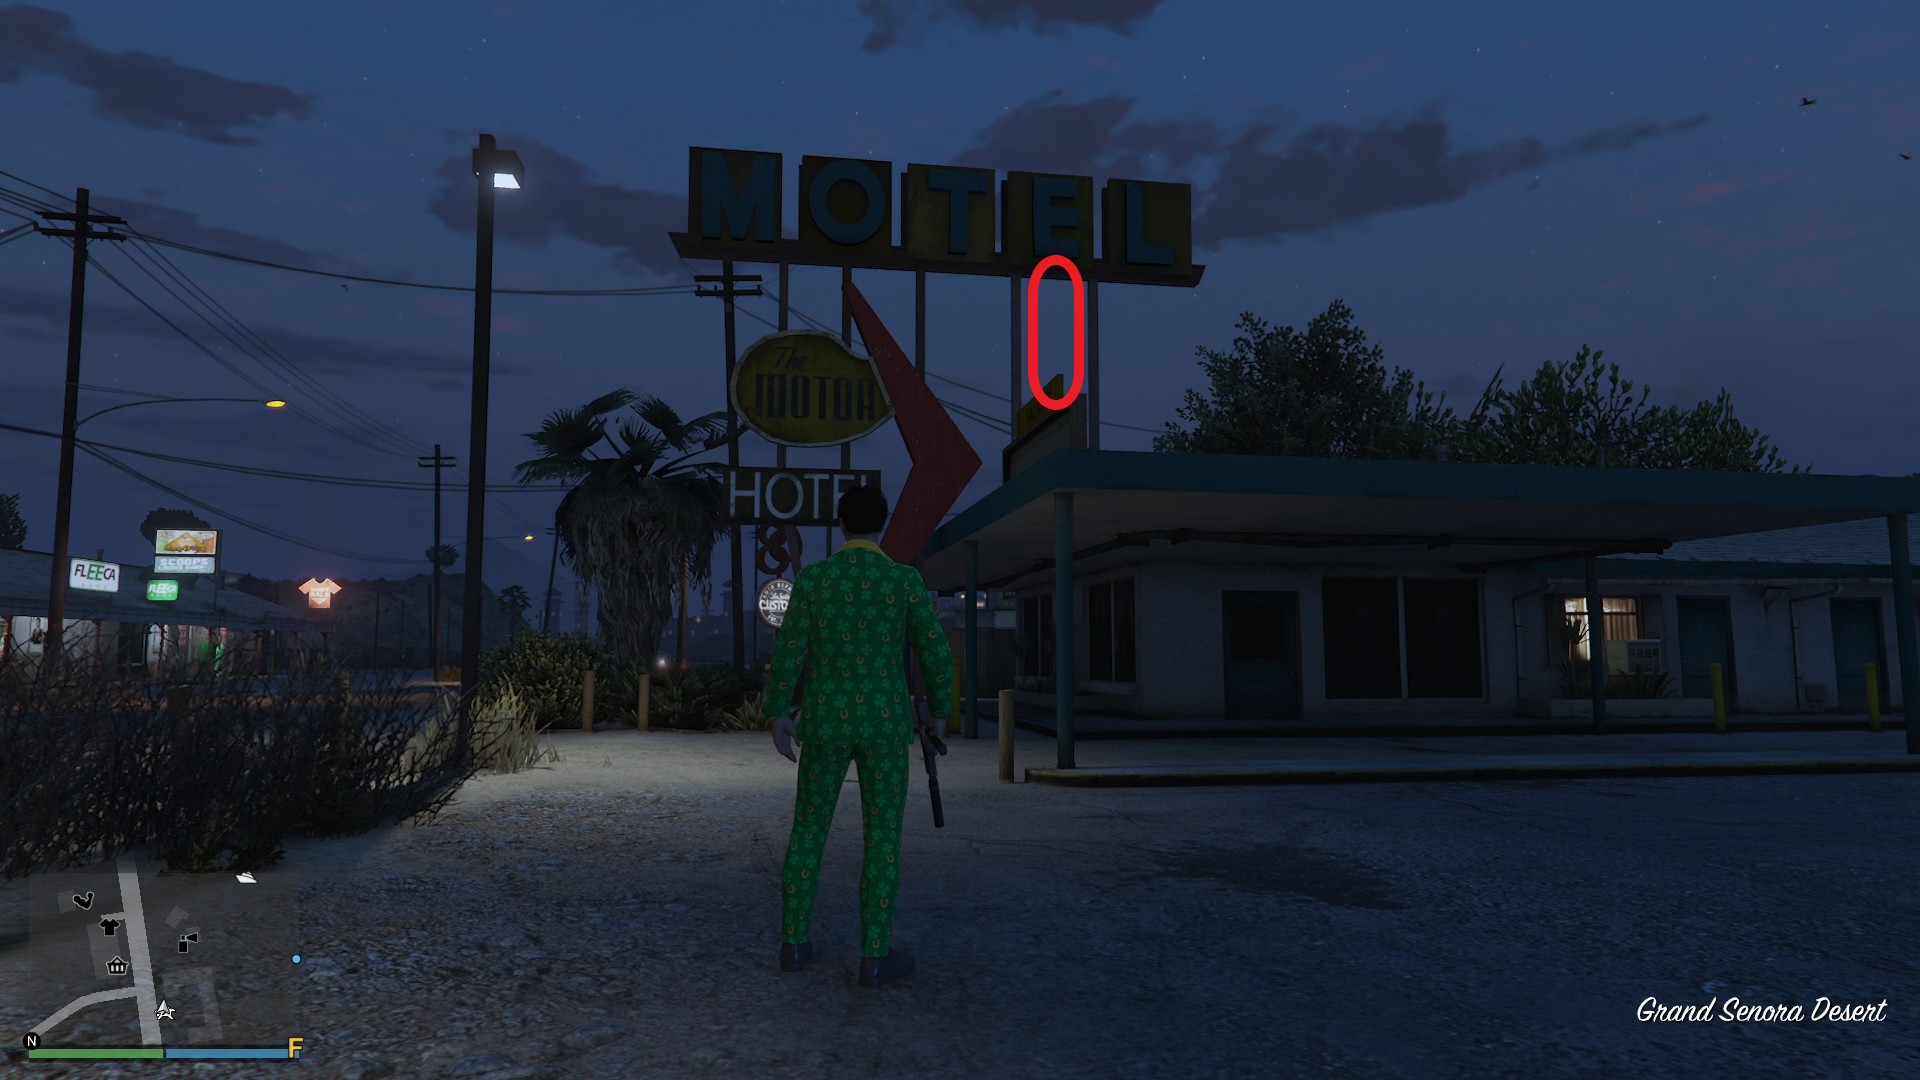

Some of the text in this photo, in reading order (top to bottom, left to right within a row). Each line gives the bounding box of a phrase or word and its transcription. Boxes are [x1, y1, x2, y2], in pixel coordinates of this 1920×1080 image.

[701, 151, 1175, 266] MOTEL
[775, 346, 808, 369] The
[756, 374, 876, 421] MOTOR
[729, 471, 867, 520] HOTE
[160, 557, 209, 566] SCOOPS
[74, 563, 116, 581] FLEECA
[148, 583, 177, 594] FLEECA
[762, 584, 775, 600] AUTO
[759, 599, 788, 611] CUSTO
